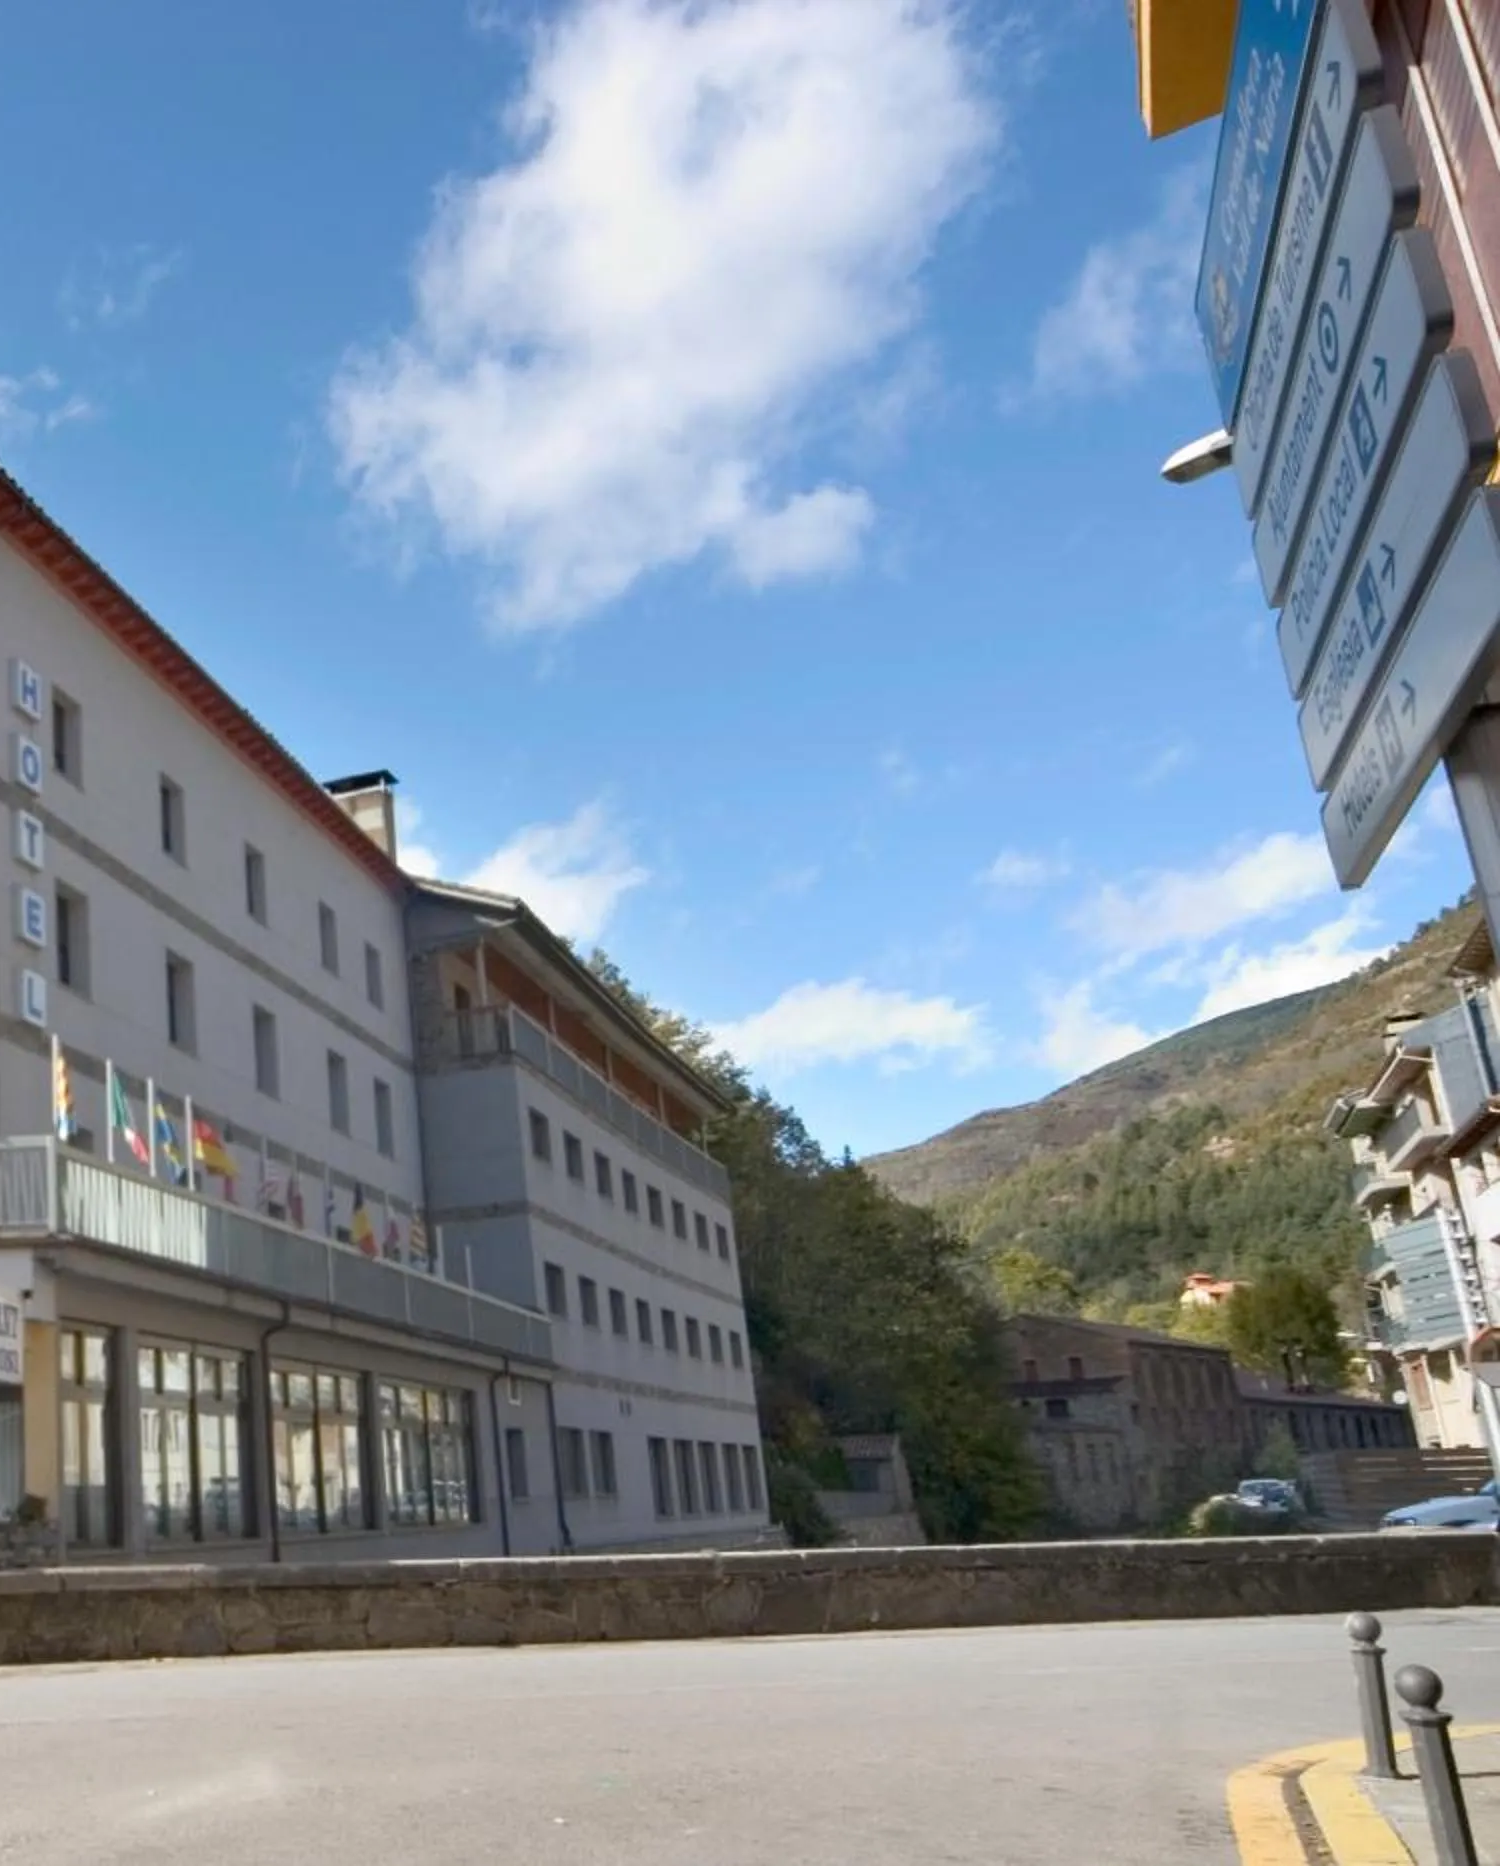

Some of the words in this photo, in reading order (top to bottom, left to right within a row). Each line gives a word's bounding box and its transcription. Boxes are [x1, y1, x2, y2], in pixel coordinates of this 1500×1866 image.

[1275, 174, 1315, 316] Turisme
[1267, 305, 1284, 361] de
[1244, 349, 1274, 451] Oficina
[1268, 352, 1323, 547] Ajuntament
[1319, 435, 1357, 553] Local
[20, 674, 43, 1022] HOTEL
[1340, 747, 1382, 839] Hotels
